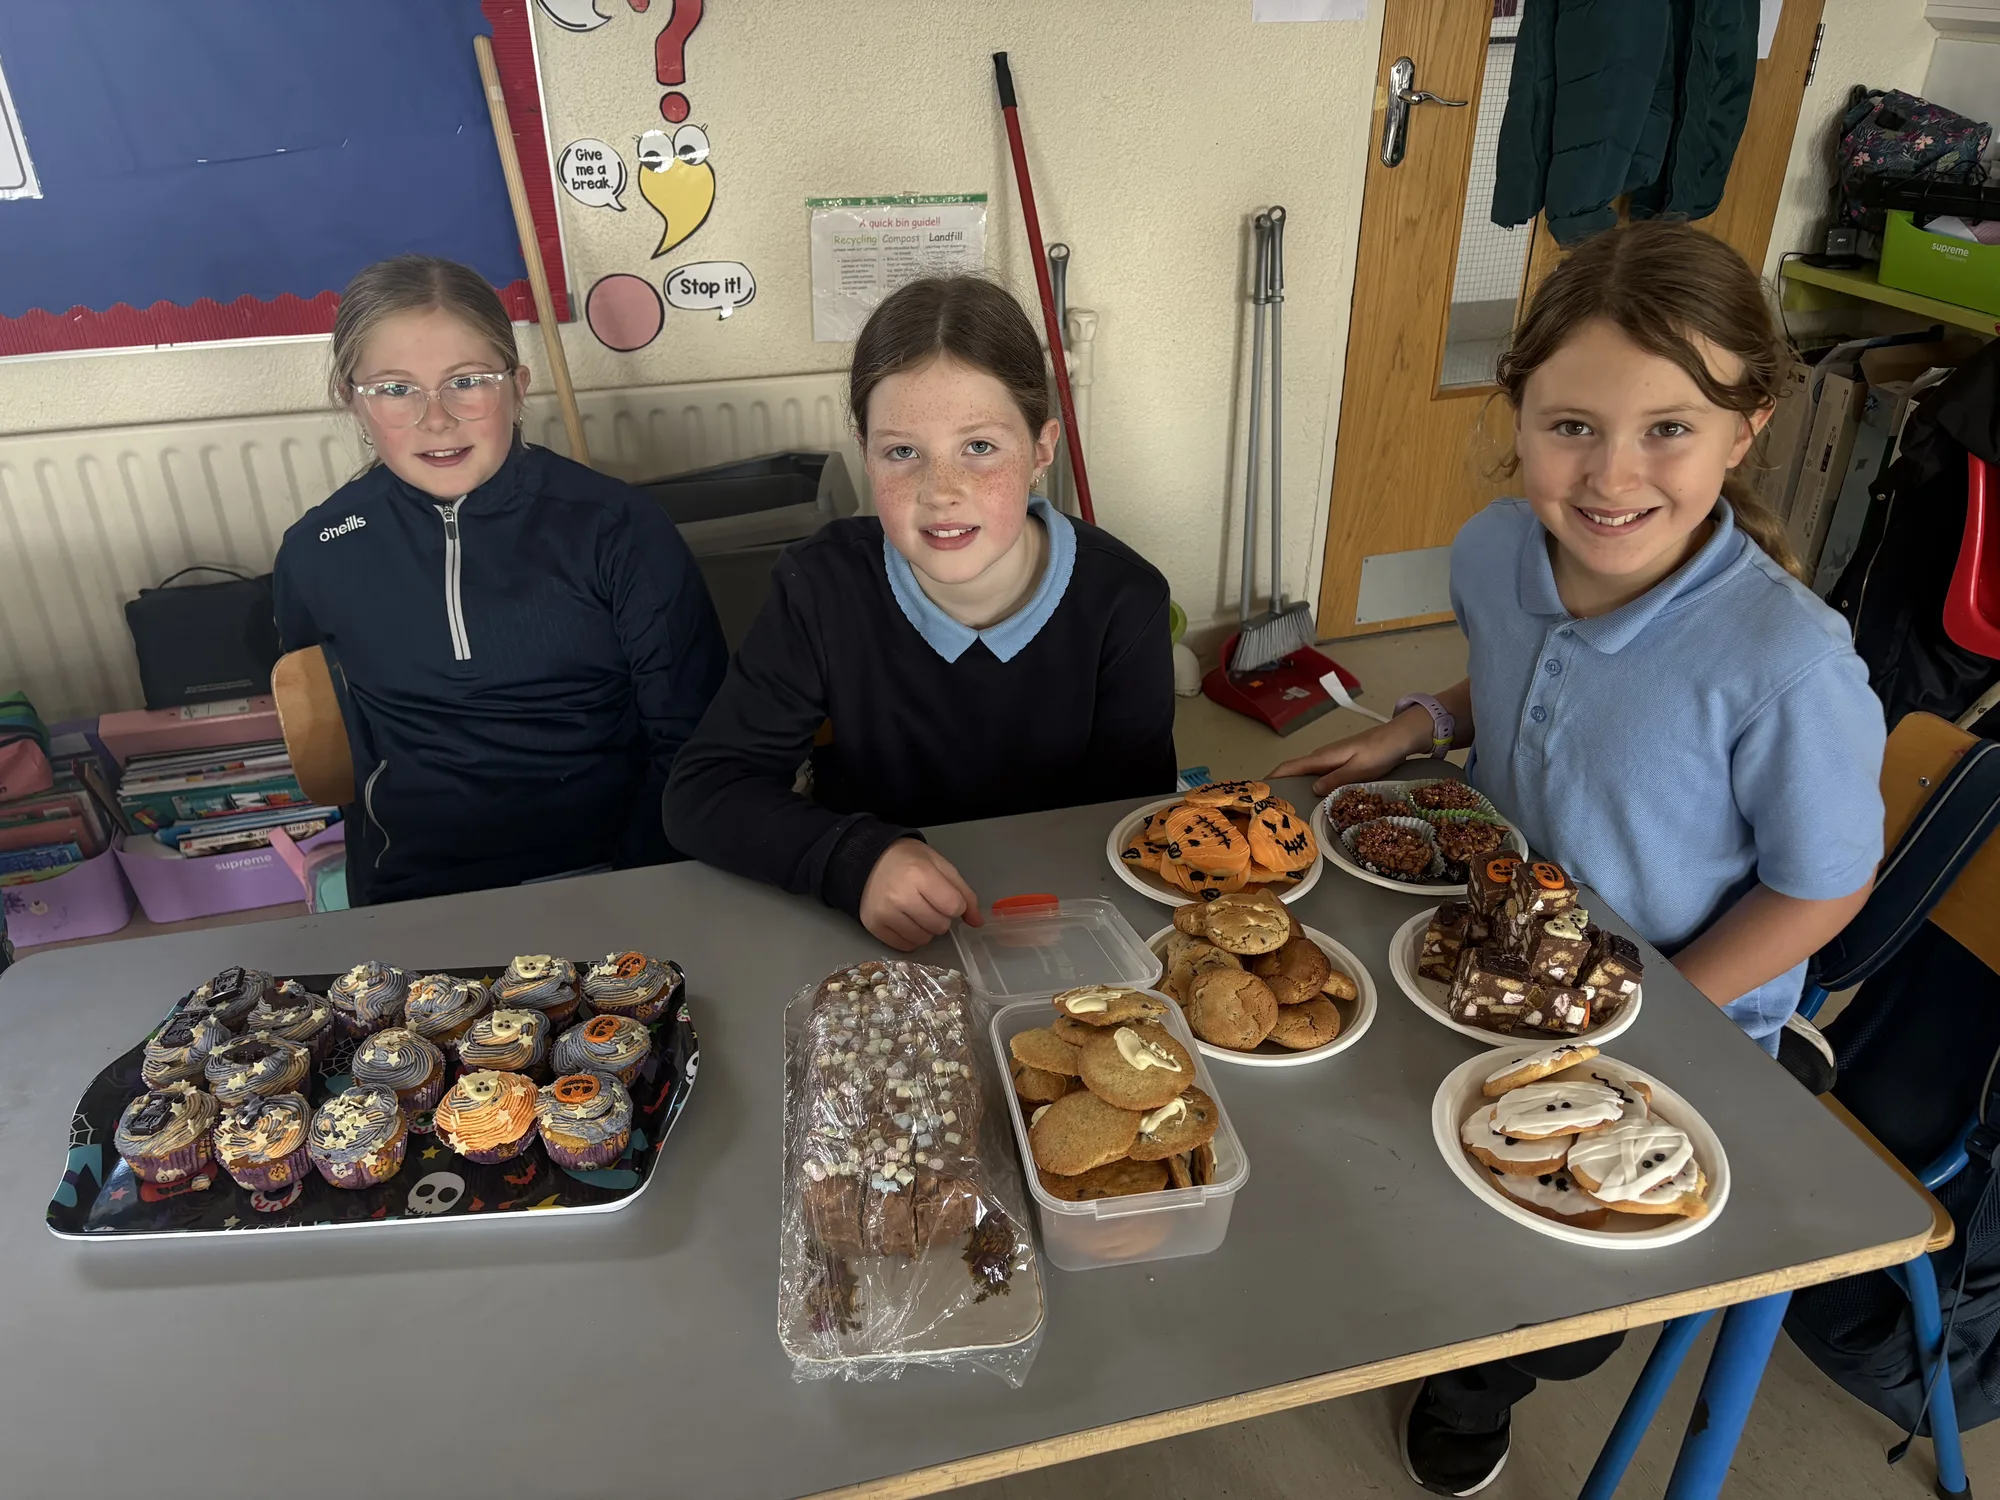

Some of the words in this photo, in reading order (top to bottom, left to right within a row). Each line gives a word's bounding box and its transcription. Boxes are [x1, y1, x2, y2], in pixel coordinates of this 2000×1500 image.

[575, 148, 603, 162] Give
[576, 165, 594, 176] me
[597, 165, 607, 176] a
[572, 178, 614, 190] break.
[859, 219, 868, 228] A
[869, 218, 893, 230] quick
[896, 218, 909, 227] bin
[911, 217, 941, 229] guide!!
[834, 234, 877, 246] Recycling
[882, 233, 920, 245] Compost
[929, 231, 963, 242] Landfill
[1931, 242, 1970, 258] supreme
[680, 278, 720, 299] Stop
[725, 277, 742, 294] it!
[215, 853, 272, 872] supreme
